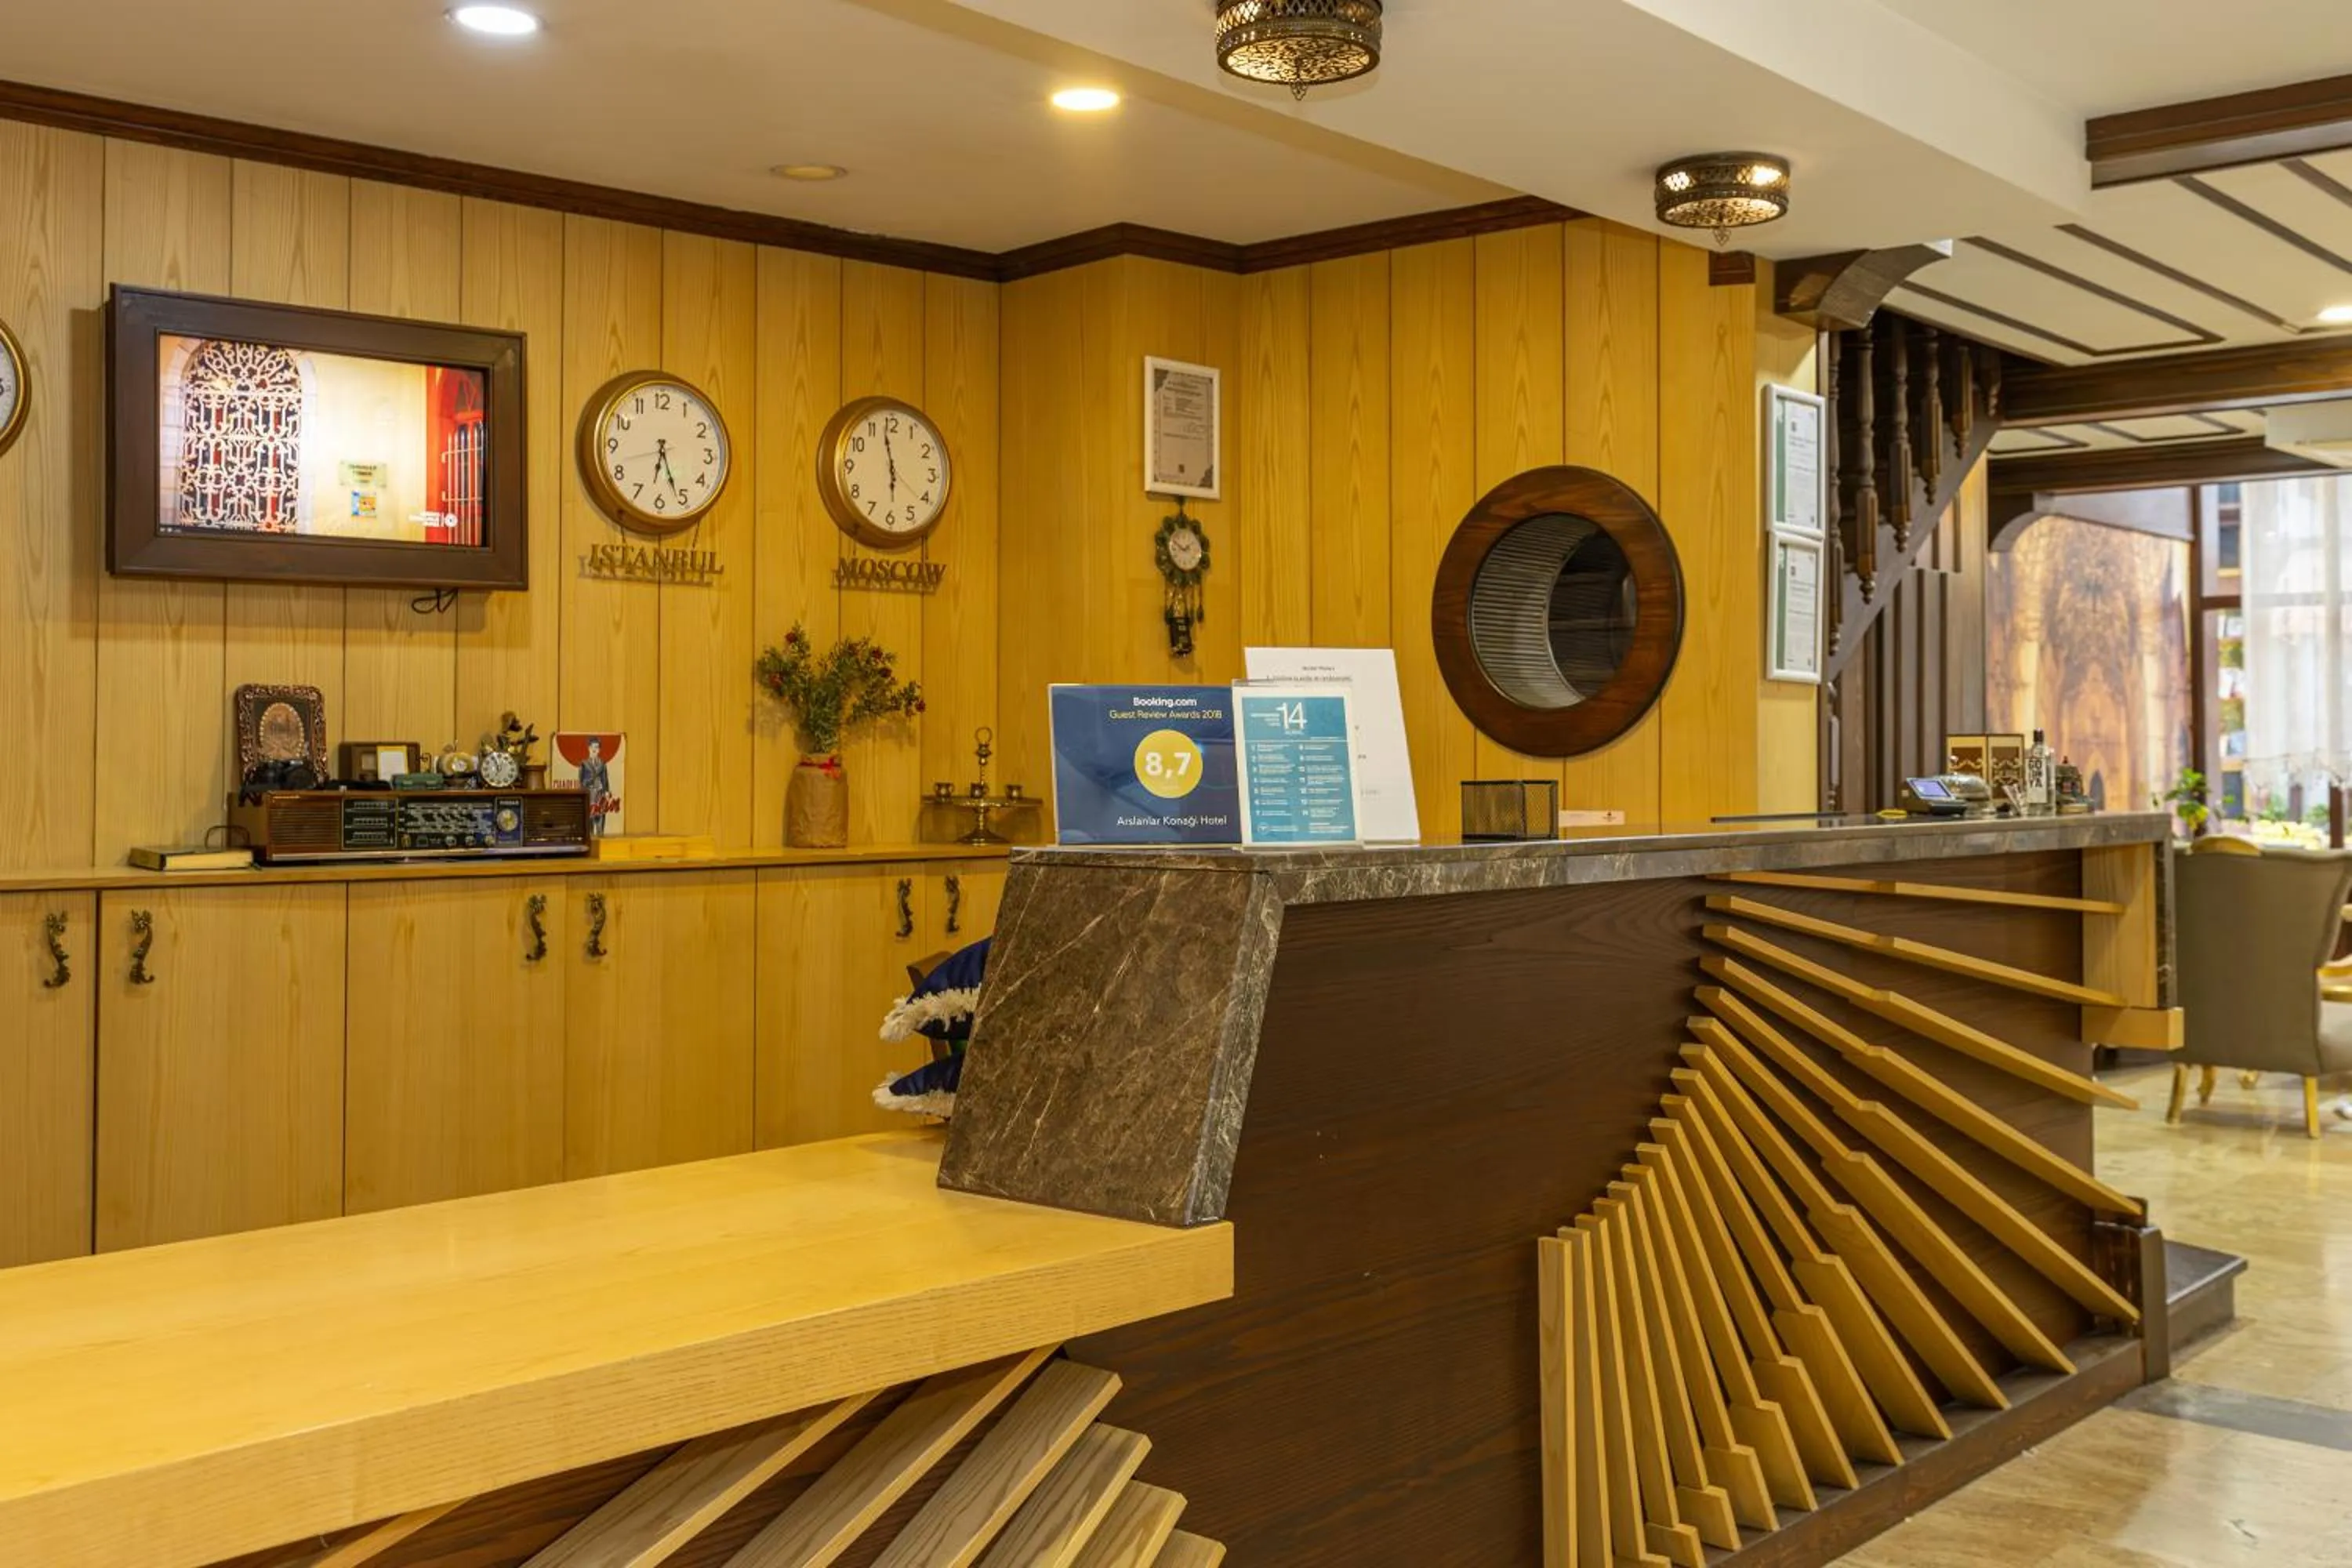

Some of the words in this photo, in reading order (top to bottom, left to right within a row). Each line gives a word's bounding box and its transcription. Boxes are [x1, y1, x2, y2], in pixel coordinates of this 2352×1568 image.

[635, 397, 644, 415] 11
[655, 393, 670, 410] 12
[683, 401, 688, 418] 1
[616, 414, 631, 430] 10
[696, 422, 706, 438] 2
[868, 422, 876, 437] 11
[909, 425, 913, 440] 1
[608, 437, 619, 454] 9
[852, 437, 865, 452] 10
[921, 443, 931, 459] 2
[703, 448, 713, 465] 3
[614, 465, 624, 481] 8
[844, 459, 855, 474] 9
[695, 472, 705, 488] 4
[927, 468, 936, 484] 3
[633, 483, 644, 500] 7
[678, 488, 688, 506] 5
[851, 484, 860, 499] 8
[920, 490, 929, 504] 4
[654, 494, 665, 510] 6
[867, 501, 877, 516] 7
[885, 510, 895, 525] 6
[906, 506, 915, 521] 5
[589, 544, 724, 575] ISTANBUL
[836, 557, 948, 584] MOSCOW
[1133, 696, 1197, 708] Booking.com
[1109, 710, 1136, 719] Guest
[1138, 710, 1167, 719] Review
[1169, 710, 1200, 719] Awards
[1202, 710, 1222, 719] 2018
[1276, 702, 1308, 730] 14
[1145, 752, 1192, 779] 8,7
[1201, 815, 1227, 825] Hotel
